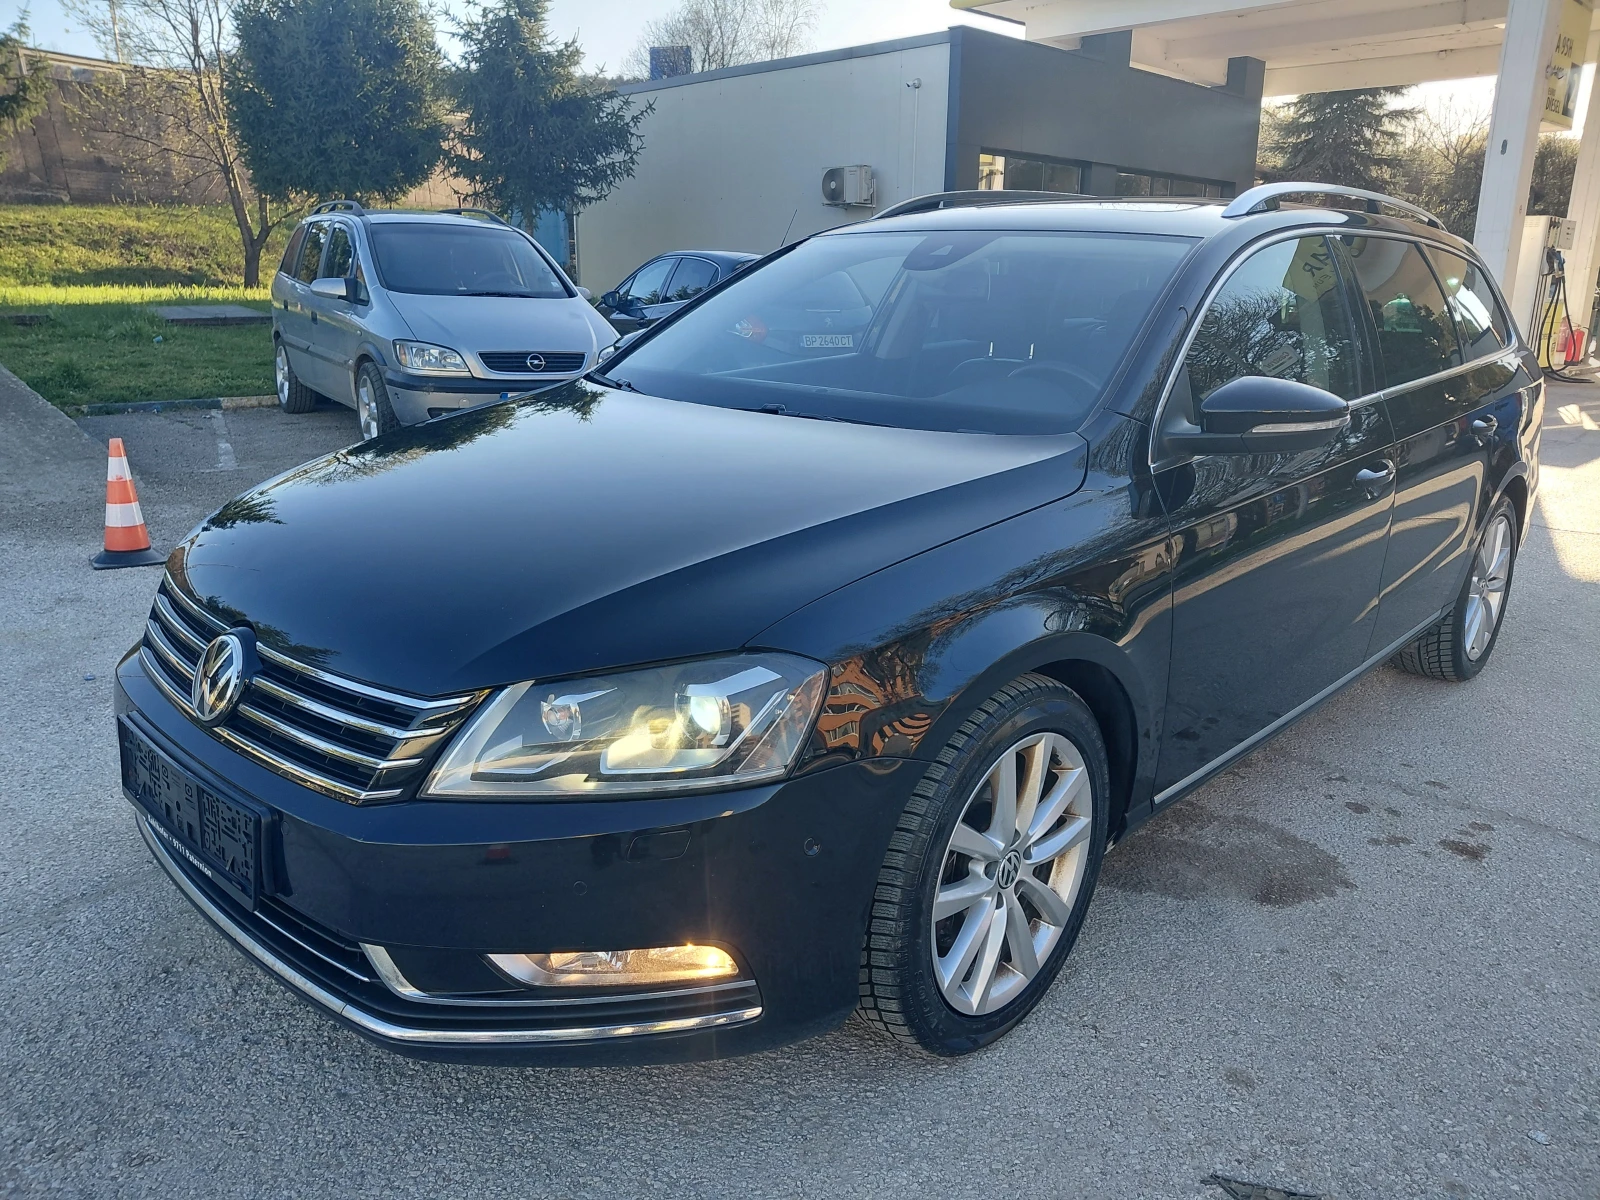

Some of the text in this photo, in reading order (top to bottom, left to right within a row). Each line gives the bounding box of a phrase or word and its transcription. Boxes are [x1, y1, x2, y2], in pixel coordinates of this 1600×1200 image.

[1546, 96, 1560, 114] DIESEL
[804, 335, 851, 347] BP 2640 CT
[172, 838, 185, 855] 9711
